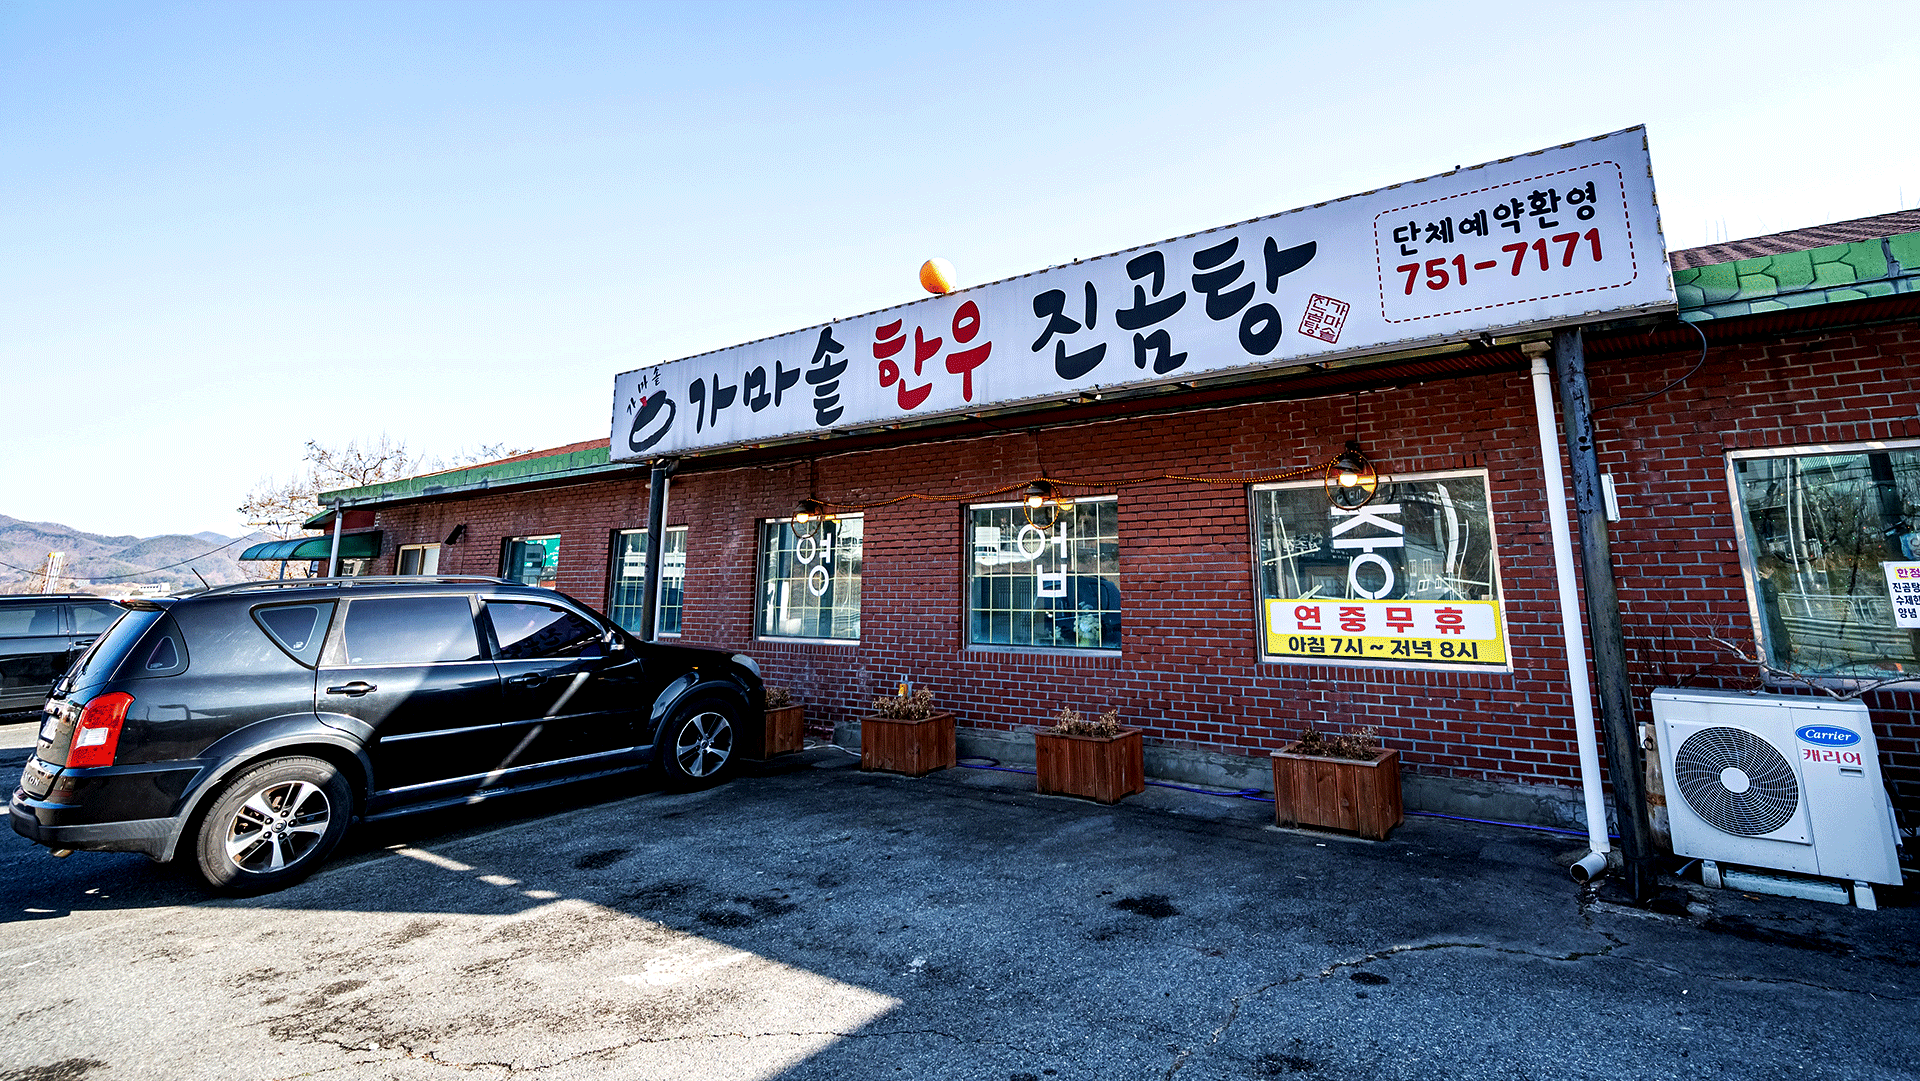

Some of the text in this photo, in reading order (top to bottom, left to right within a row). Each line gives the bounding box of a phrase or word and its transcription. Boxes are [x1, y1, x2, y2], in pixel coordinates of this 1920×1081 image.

[1393, 181, 1597, 256] 단체예약환영
[1396, 228, 1603, 295] 751-7171
[873, 300, 992, 410] 한우
[1031, 236, 1317, 380] 진곰탕
[796, 533, 832, 597] 영
[1017, 521, 1068, 598] 업
[1288, 636, 1325, 653] 아침
[1330, 638, 1364, 655] 7시
[1390, 639, 1433, 657] 저녁
[1439, 641, 1478, 660] 8시
[1802, 748, 1862, 766] 캐리어
[1805, 729, 1852, 741] Carrier
